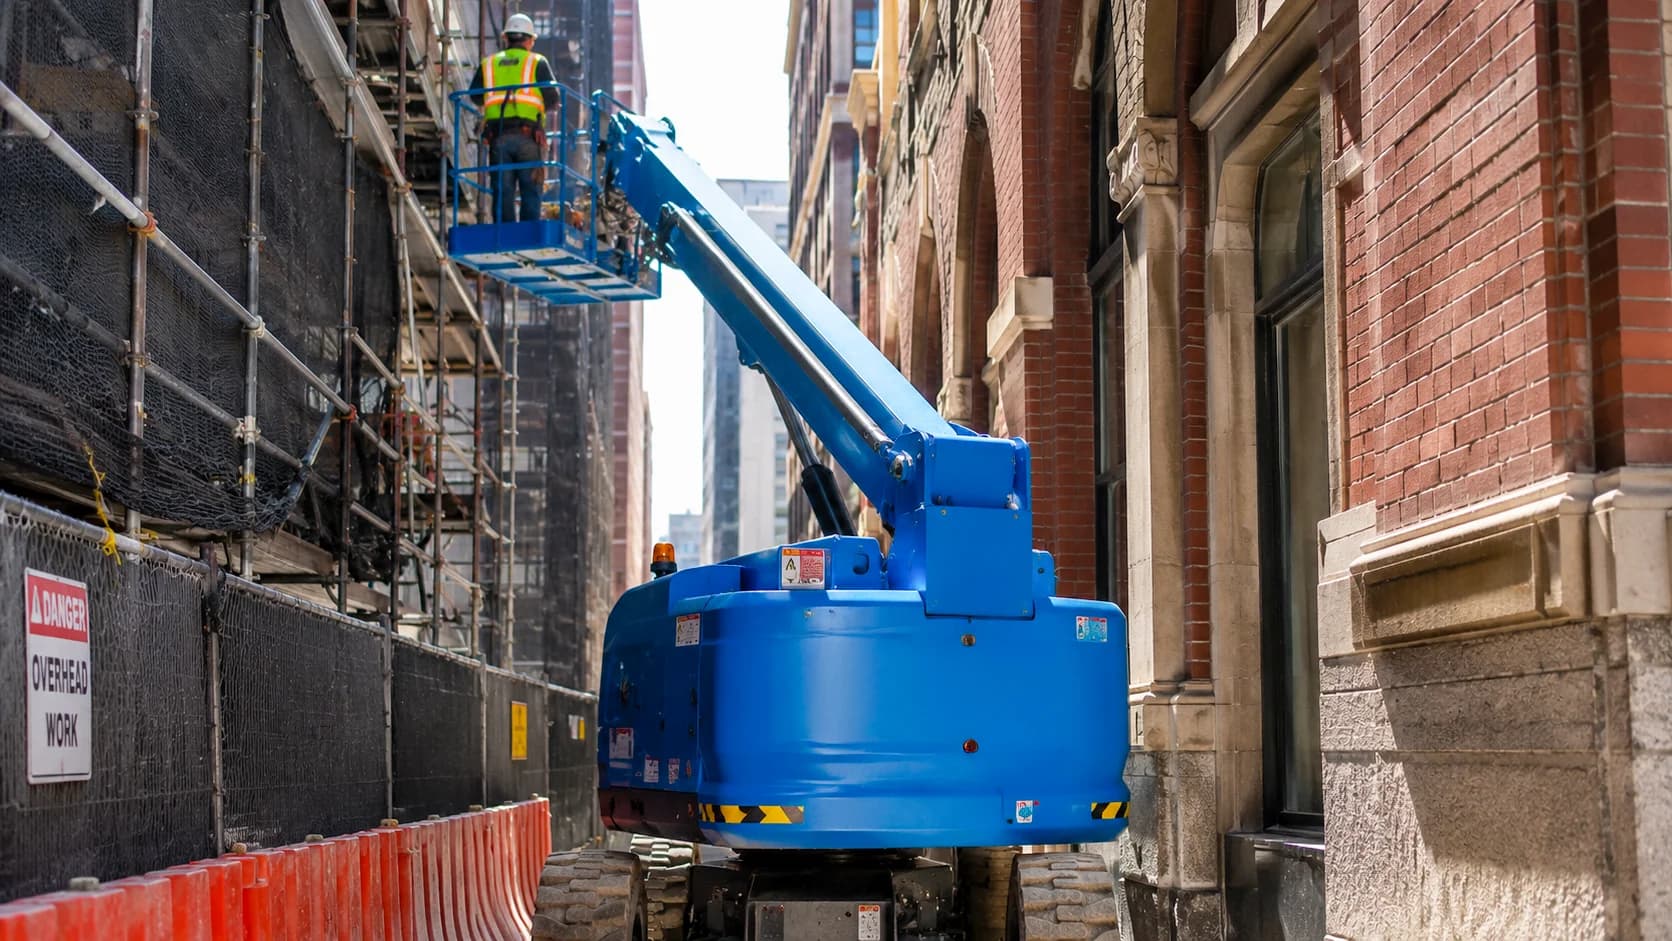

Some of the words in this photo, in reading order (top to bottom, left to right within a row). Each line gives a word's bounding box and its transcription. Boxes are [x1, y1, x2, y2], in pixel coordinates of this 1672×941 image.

[43, 590, 86, 632] DANGER
[32, 654, 87, 695] OVERHEAD
[45, 712, 78, 747] WORK
